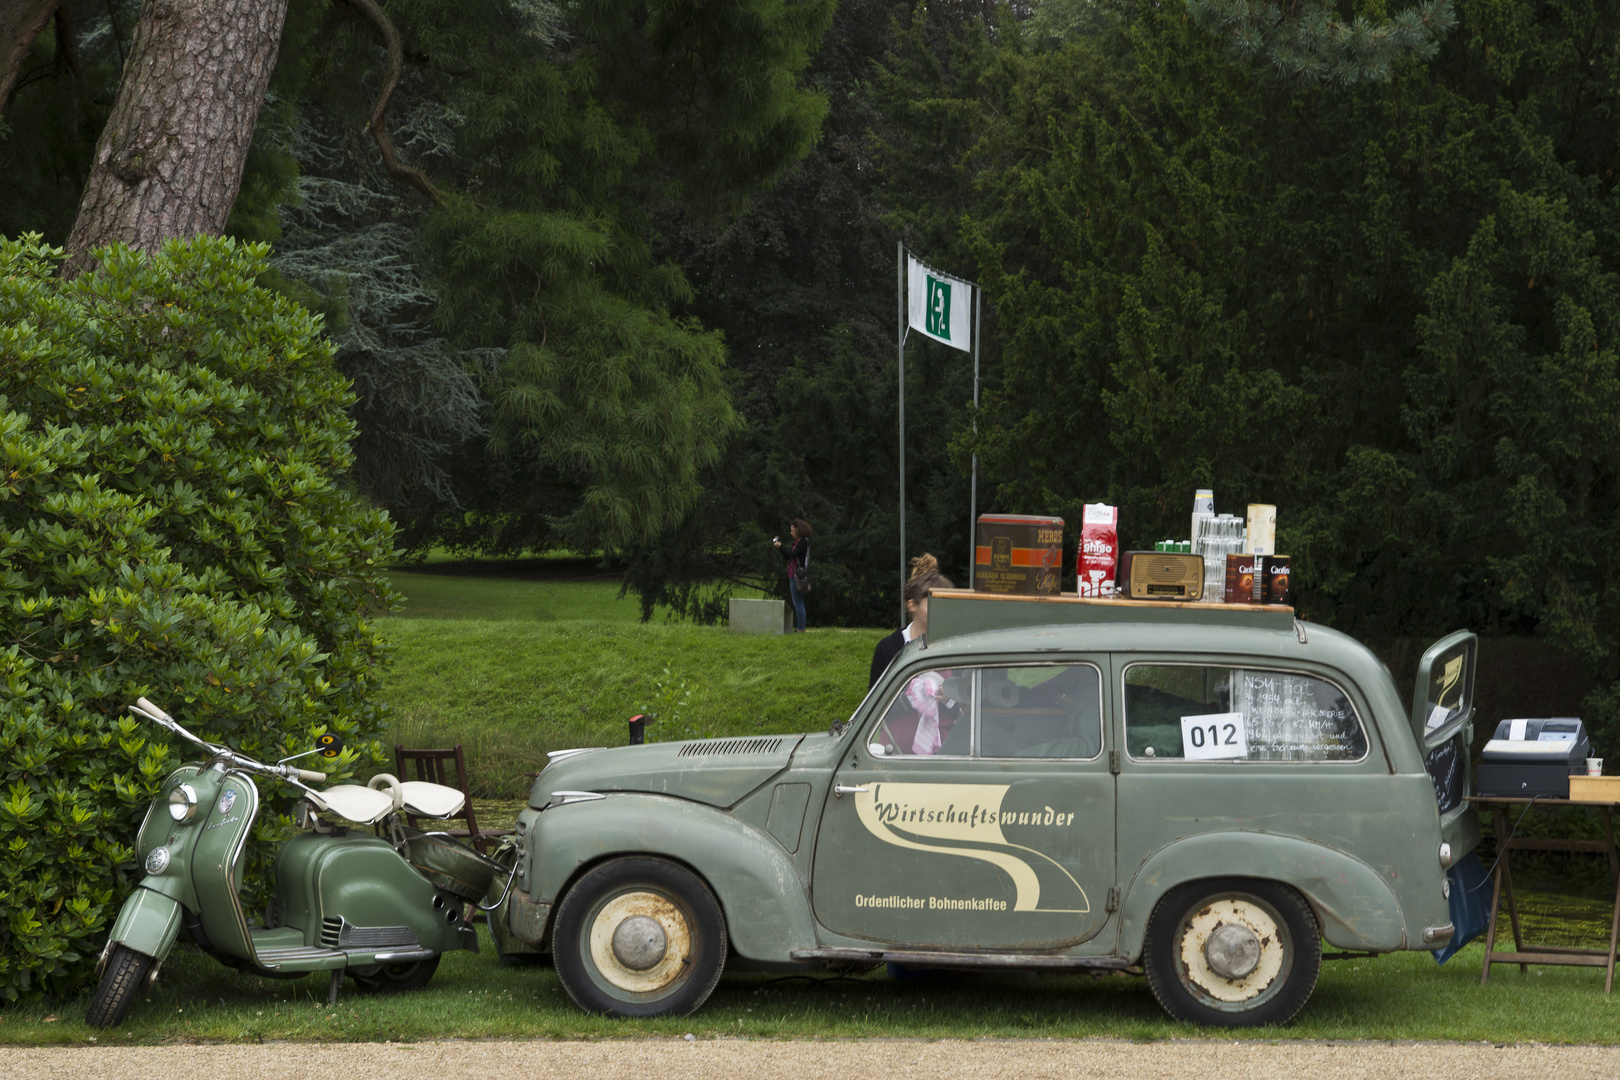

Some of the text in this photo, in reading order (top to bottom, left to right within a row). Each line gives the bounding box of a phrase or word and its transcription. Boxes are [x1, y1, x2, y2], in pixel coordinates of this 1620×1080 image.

[1037, 529, 1063, 543] HEROS
[1083, 540, 1113, 554] ghigo
[1257, 694, 1280, 704] 1954
[1191, 723, 1238, 748] 012
[874, 801, 1074, 828] Wirtschaftswunder
[855, 893, 1007, 911] Ordentlicher Bohnenkaffee
